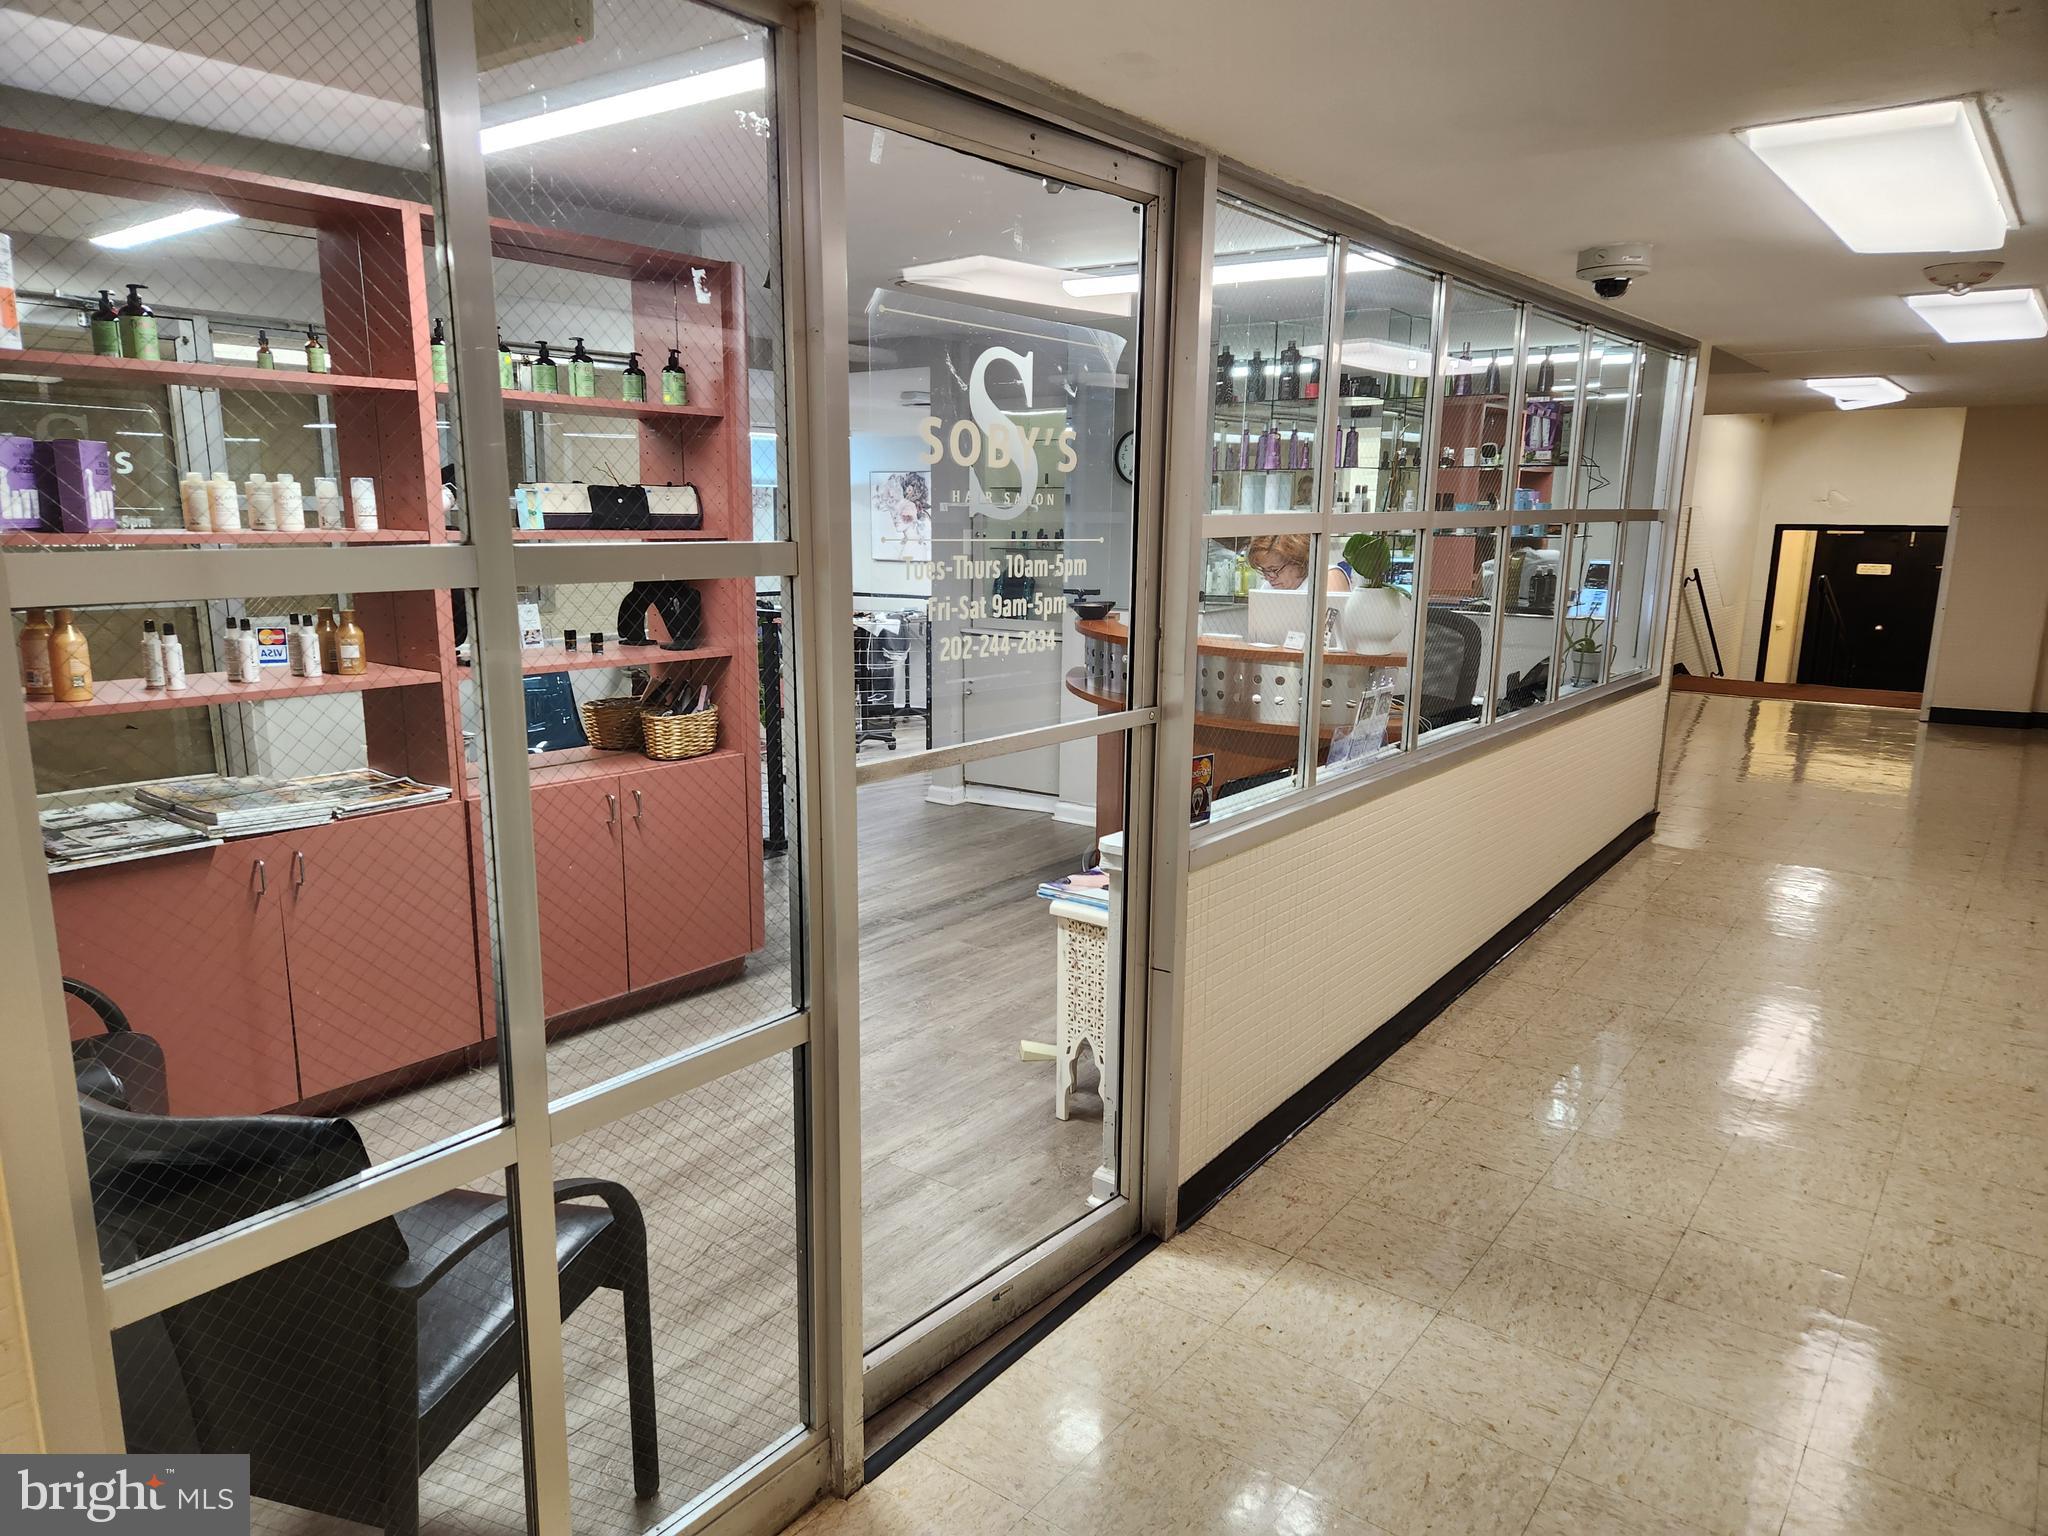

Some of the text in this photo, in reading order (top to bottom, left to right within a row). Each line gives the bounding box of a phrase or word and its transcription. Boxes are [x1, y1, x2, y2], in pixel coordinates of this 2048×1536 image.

[920, 416, 1078, 473] SOBY'S
[969, 346, 1039, 520] S
[952, 490, 1055, 506] HAR SAON
[903, 553, 1087, 582] Tues-Thurs 10am-5pm
[928, 592, 1067, 622] Fri-Sat 9am-5pm
[940, 629, 1057, 662] 202-244-2634
